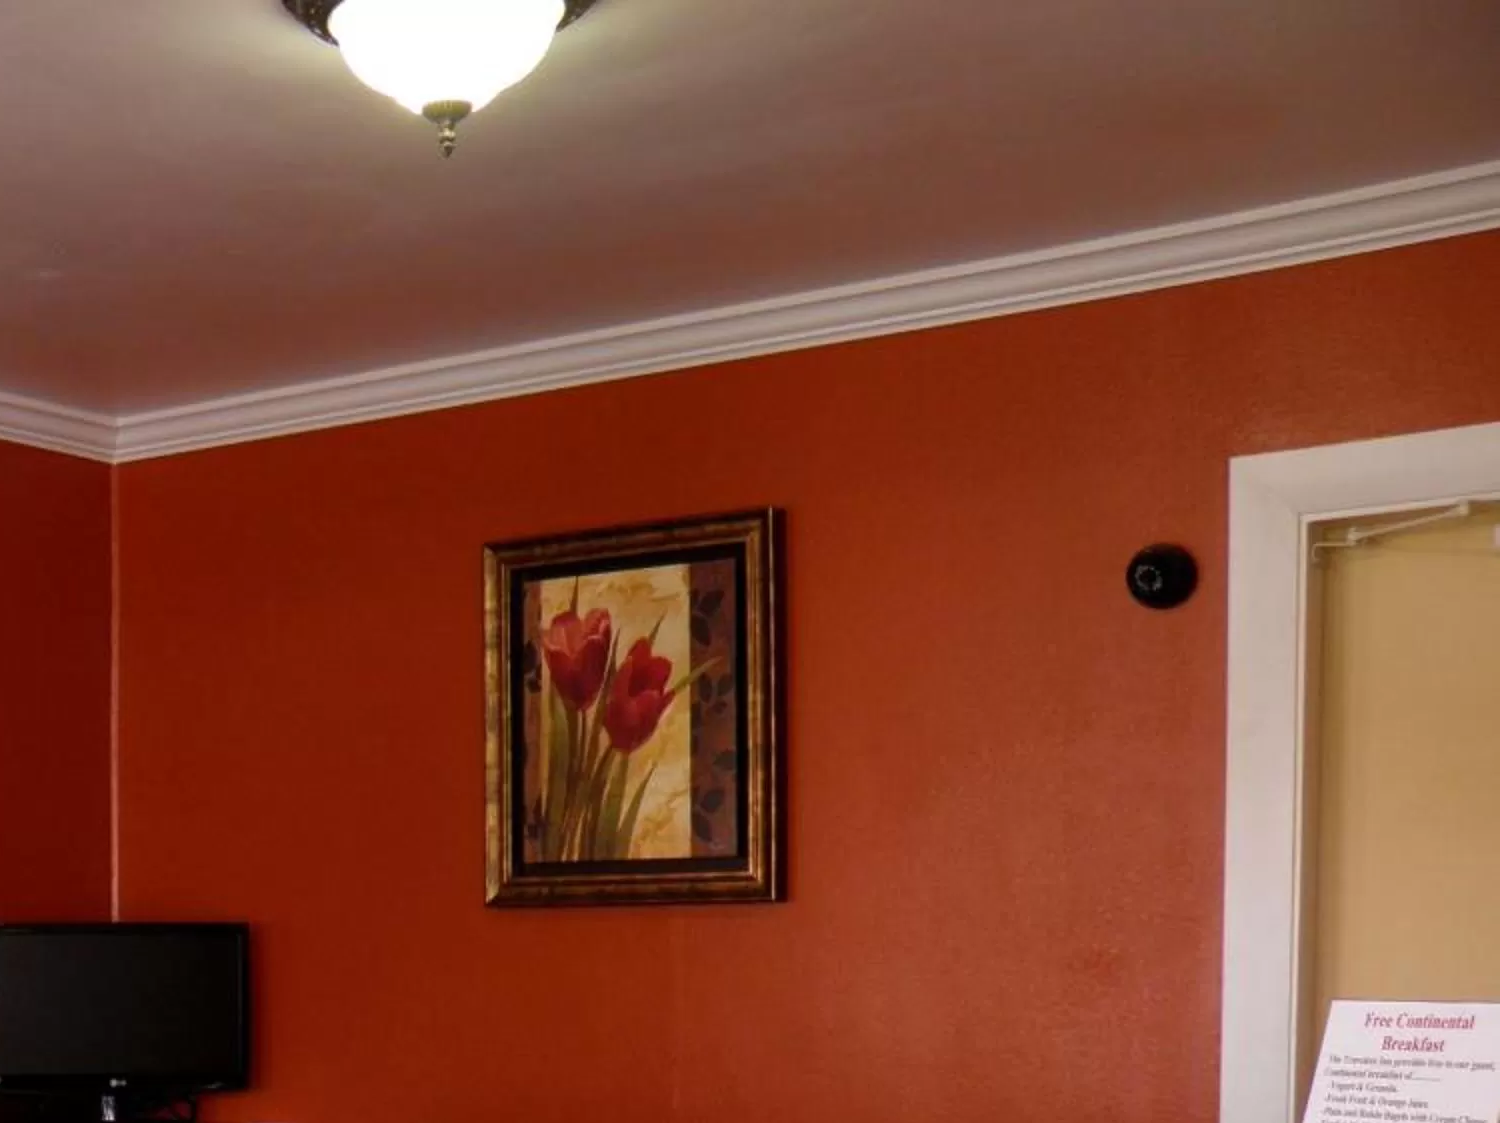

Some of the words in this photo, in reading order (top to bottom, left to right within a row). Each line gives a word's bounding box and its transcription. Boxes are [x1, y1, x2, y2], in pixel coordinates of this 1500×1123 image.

[1364, 1012, 1394, 1029] Free
[1395, 1013, 1475, 1031] Continental
[1381, 1035, 1445, 1053] Breakfast
